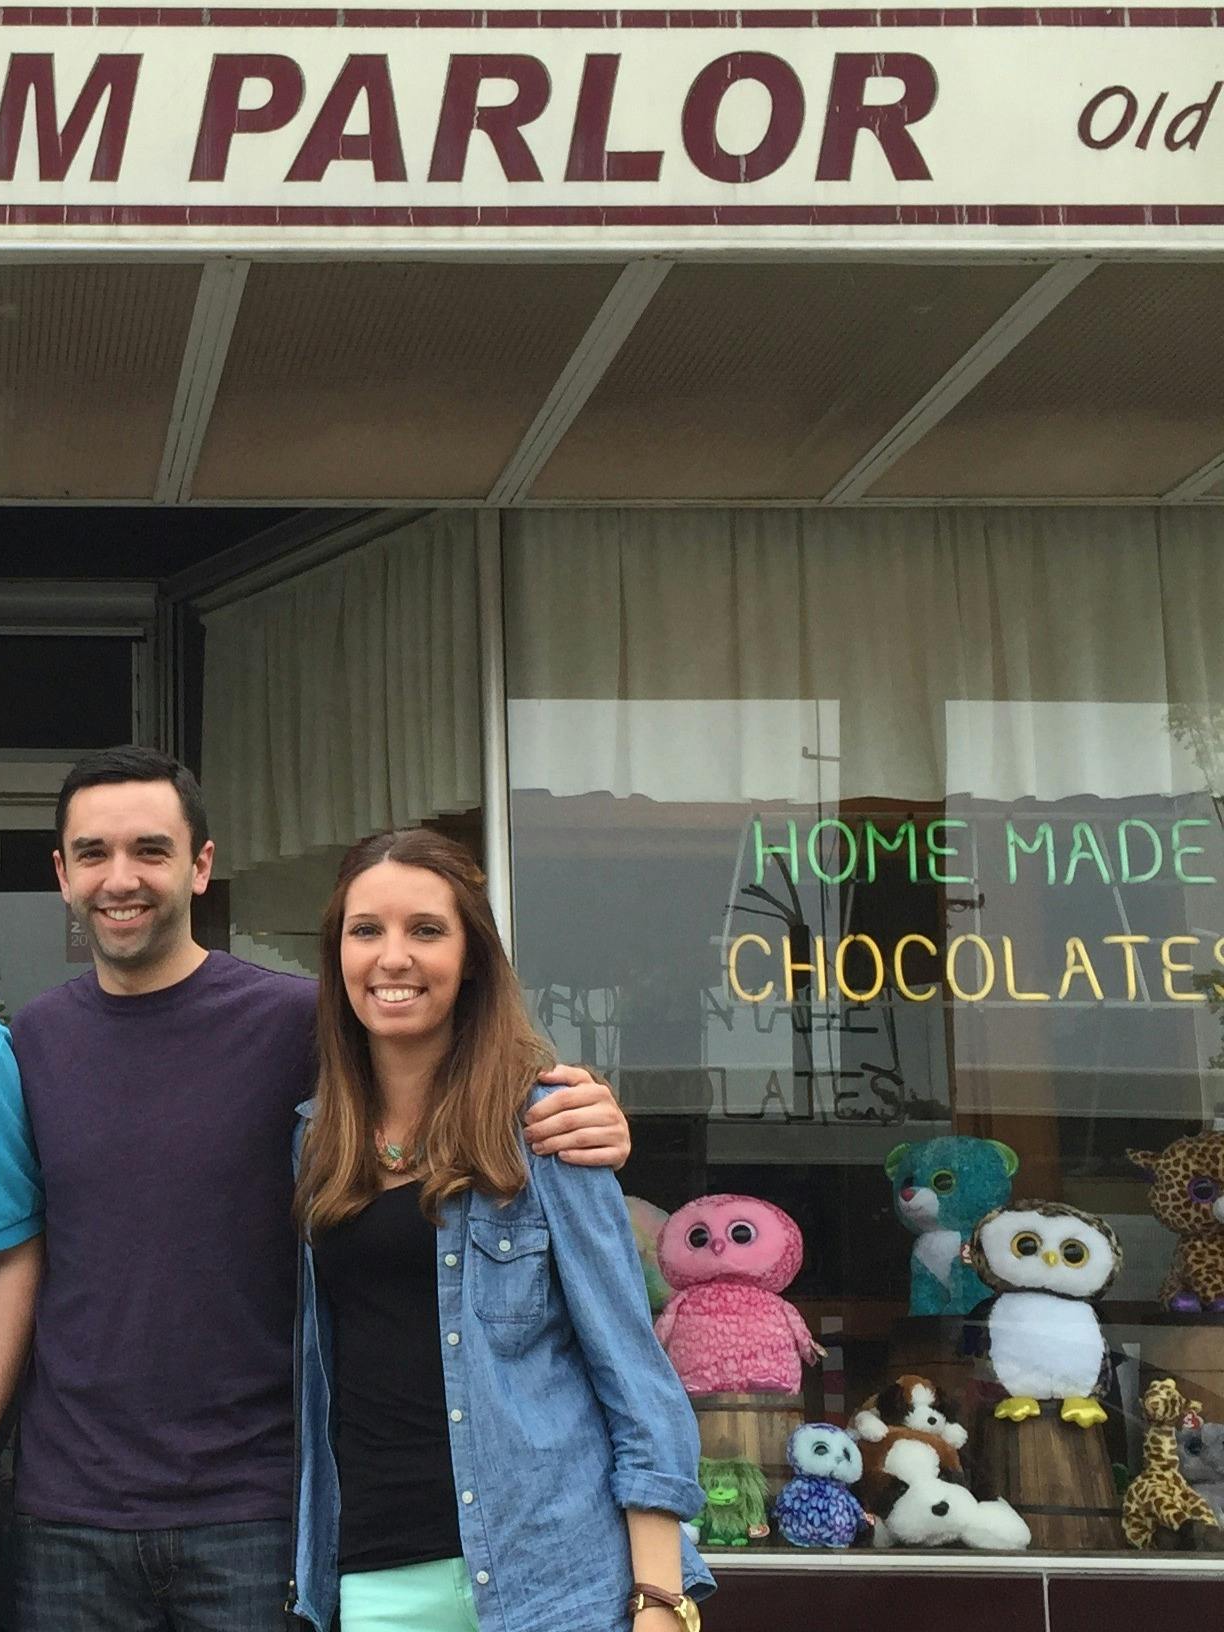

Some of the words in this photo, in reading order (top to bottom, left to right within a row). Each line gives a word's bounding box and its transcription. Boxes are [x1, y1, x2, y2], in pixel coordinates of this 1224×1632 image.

[188, 50, 940, 185] PARLOR
[1077, 80, 1224, 152] Old
[752, 819, 972, 885] HOME
[1006, 819, 1218, 885] MADE
